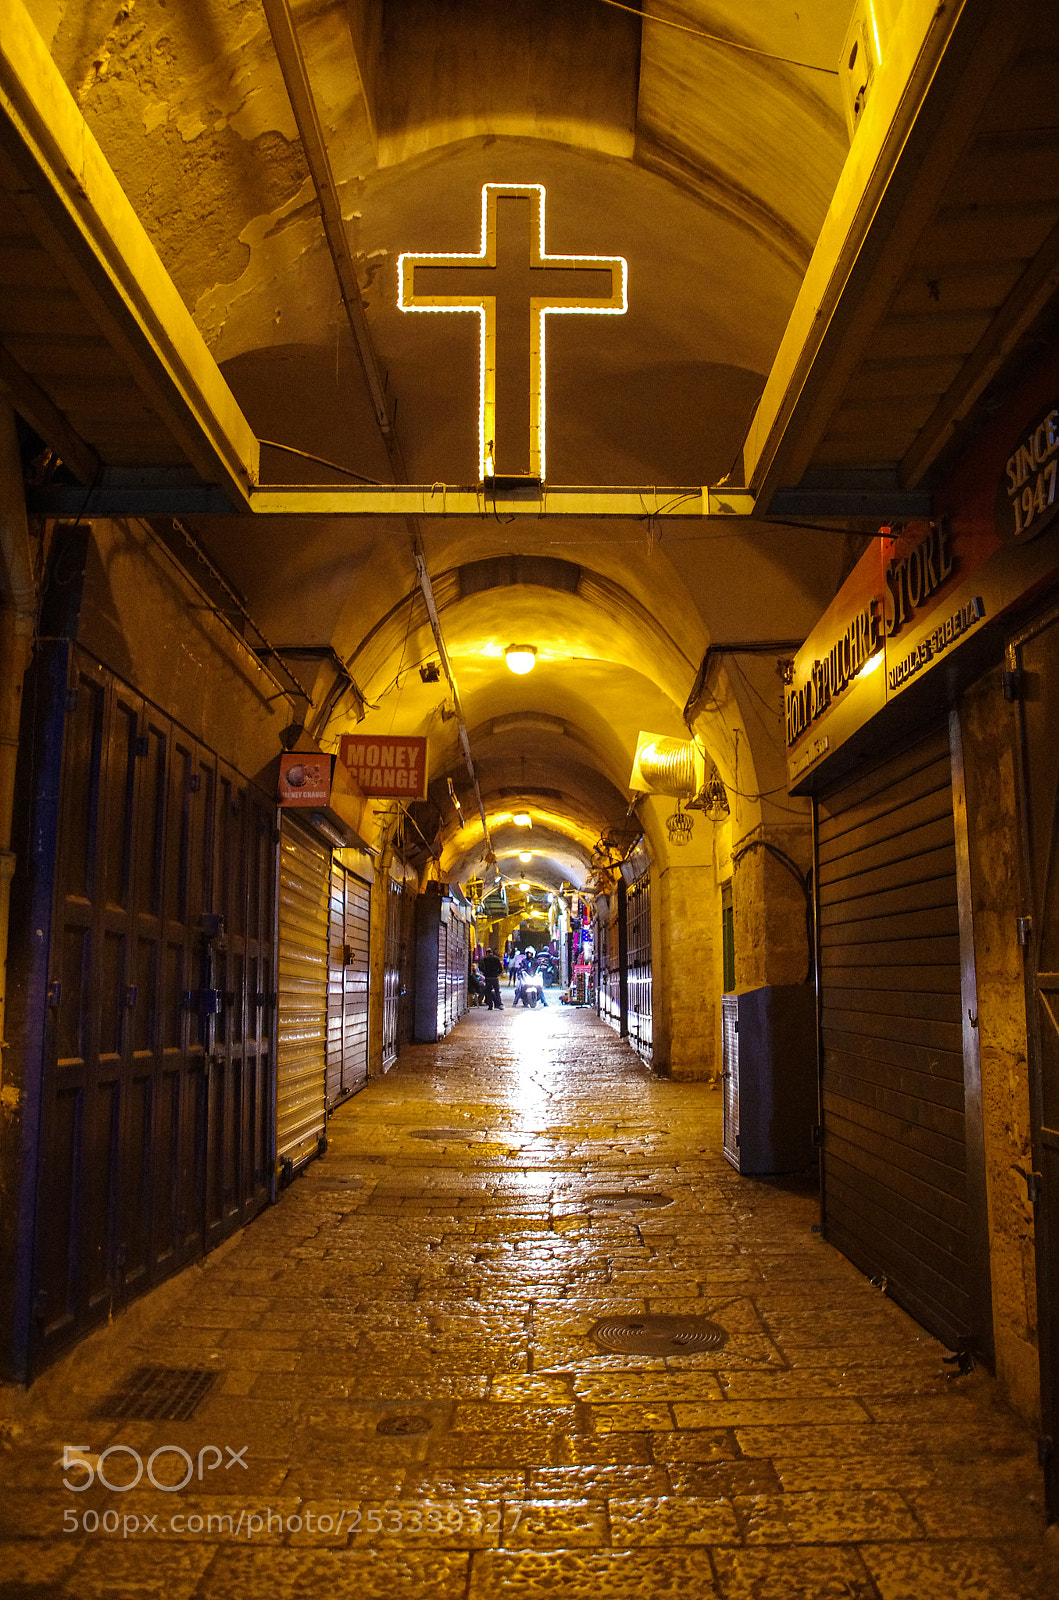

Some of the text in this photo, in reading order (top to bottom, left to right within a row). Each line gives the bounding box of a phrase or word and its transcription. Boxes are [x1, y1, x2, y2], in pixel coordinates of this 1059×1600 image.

[1006, 409, 1059, 496] SINCE
[1012, 459, 1058, 536] 1947
[786, 681, 811, 746] HOLY
[811, 597, 881, 719] SEPULCHRE
[885, 516, 953, 636] STORE
[889, 639, 930, 689] NICOLAS
[346, 744, 420, 768] MONEY
